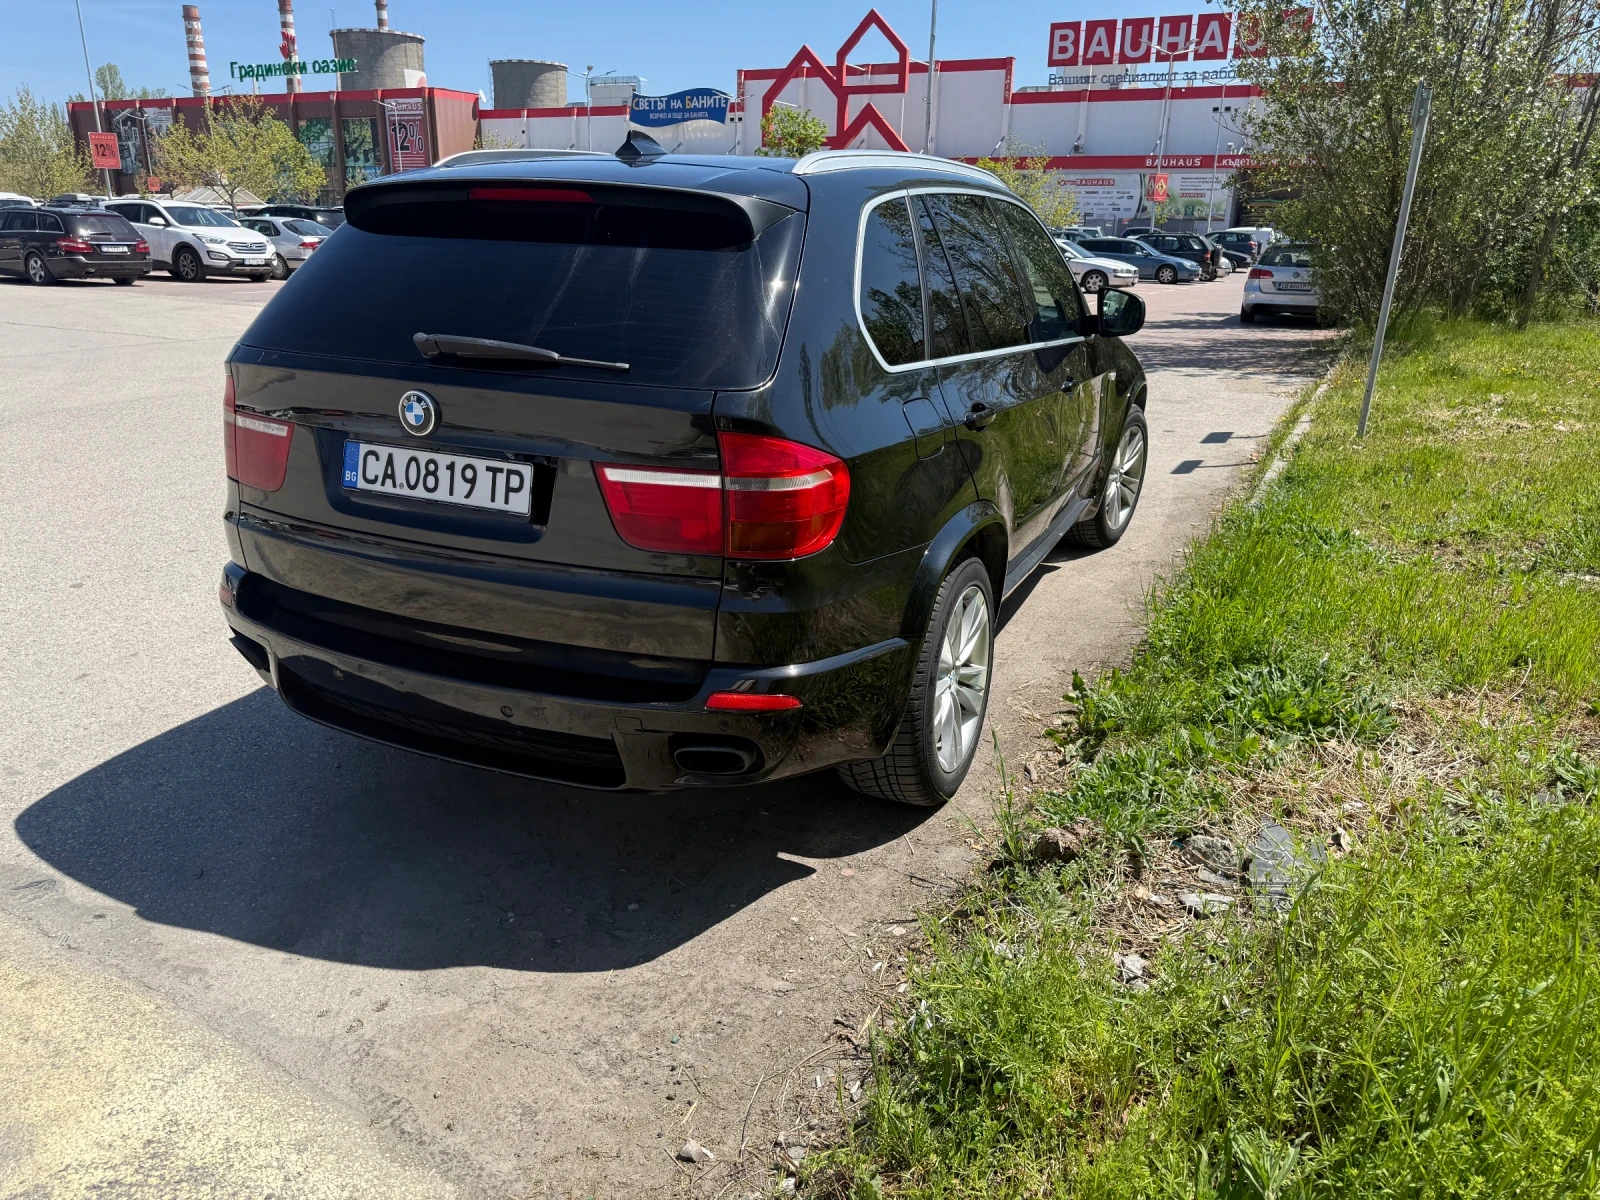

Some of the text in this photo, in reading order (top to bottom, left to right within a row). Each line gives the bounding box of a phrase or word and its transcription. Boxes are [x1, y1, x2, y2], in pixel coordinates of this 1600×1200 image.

[230, 57, 356, 82] Градински оазис
[1048, 73, 1097, 86] Вашият
[1101, 70, 1177, 85] специалист
[1182, 71, 1196, 80] за
[632, 95, 726, 111] СВЕТЪТ НА БАНИТЕ
[391, 122, 424, 153] 12%
[95, 143, 115, 157] 12%
[1146, 158, 1201, 167] BAUHAUS
[402, 395, 427, 409] BMW
[345, 471, 357, 481] BG
